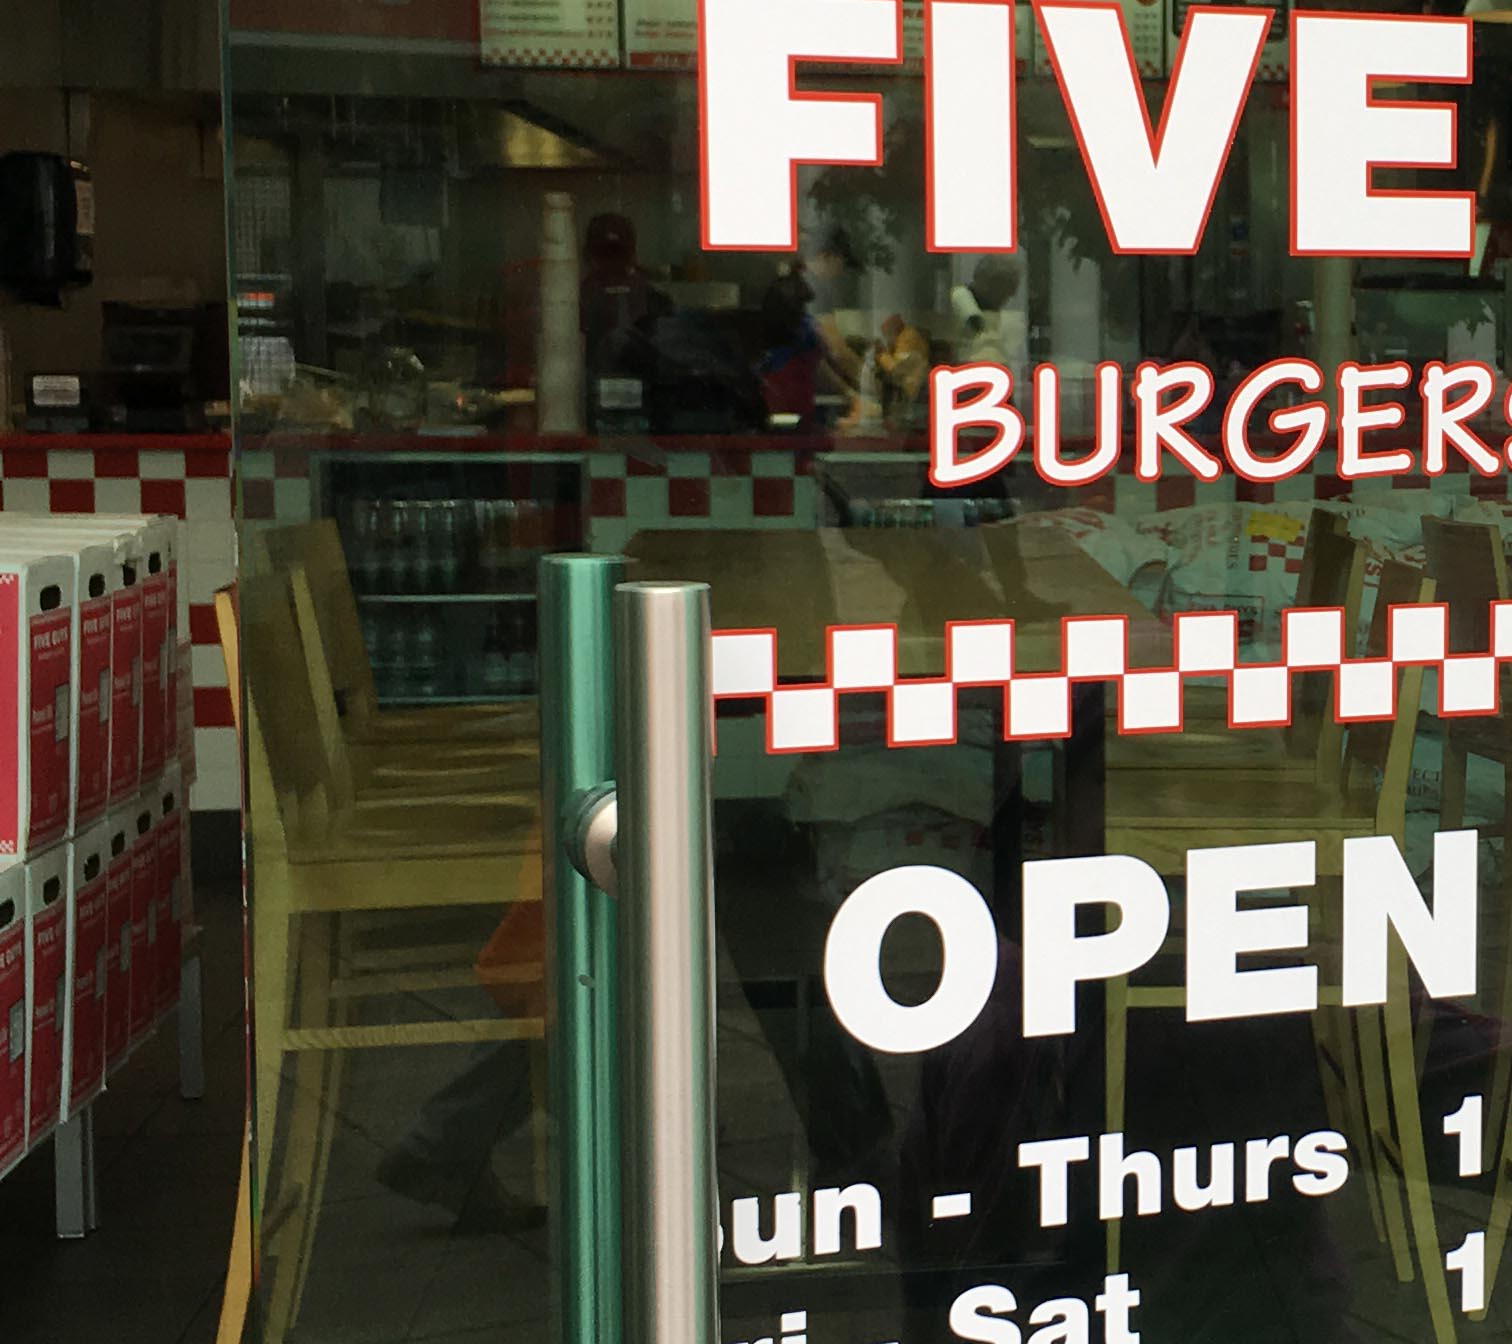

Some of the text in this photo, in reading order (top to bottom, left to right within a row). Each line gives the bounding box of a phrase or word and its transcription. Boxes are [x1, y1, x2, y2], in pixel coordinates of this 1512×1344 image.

[825, 830, 1477, 1052] OPEN
[721, 1183, 881, 1263] un
[1019, 1132, 1348, 1226] Thurs
